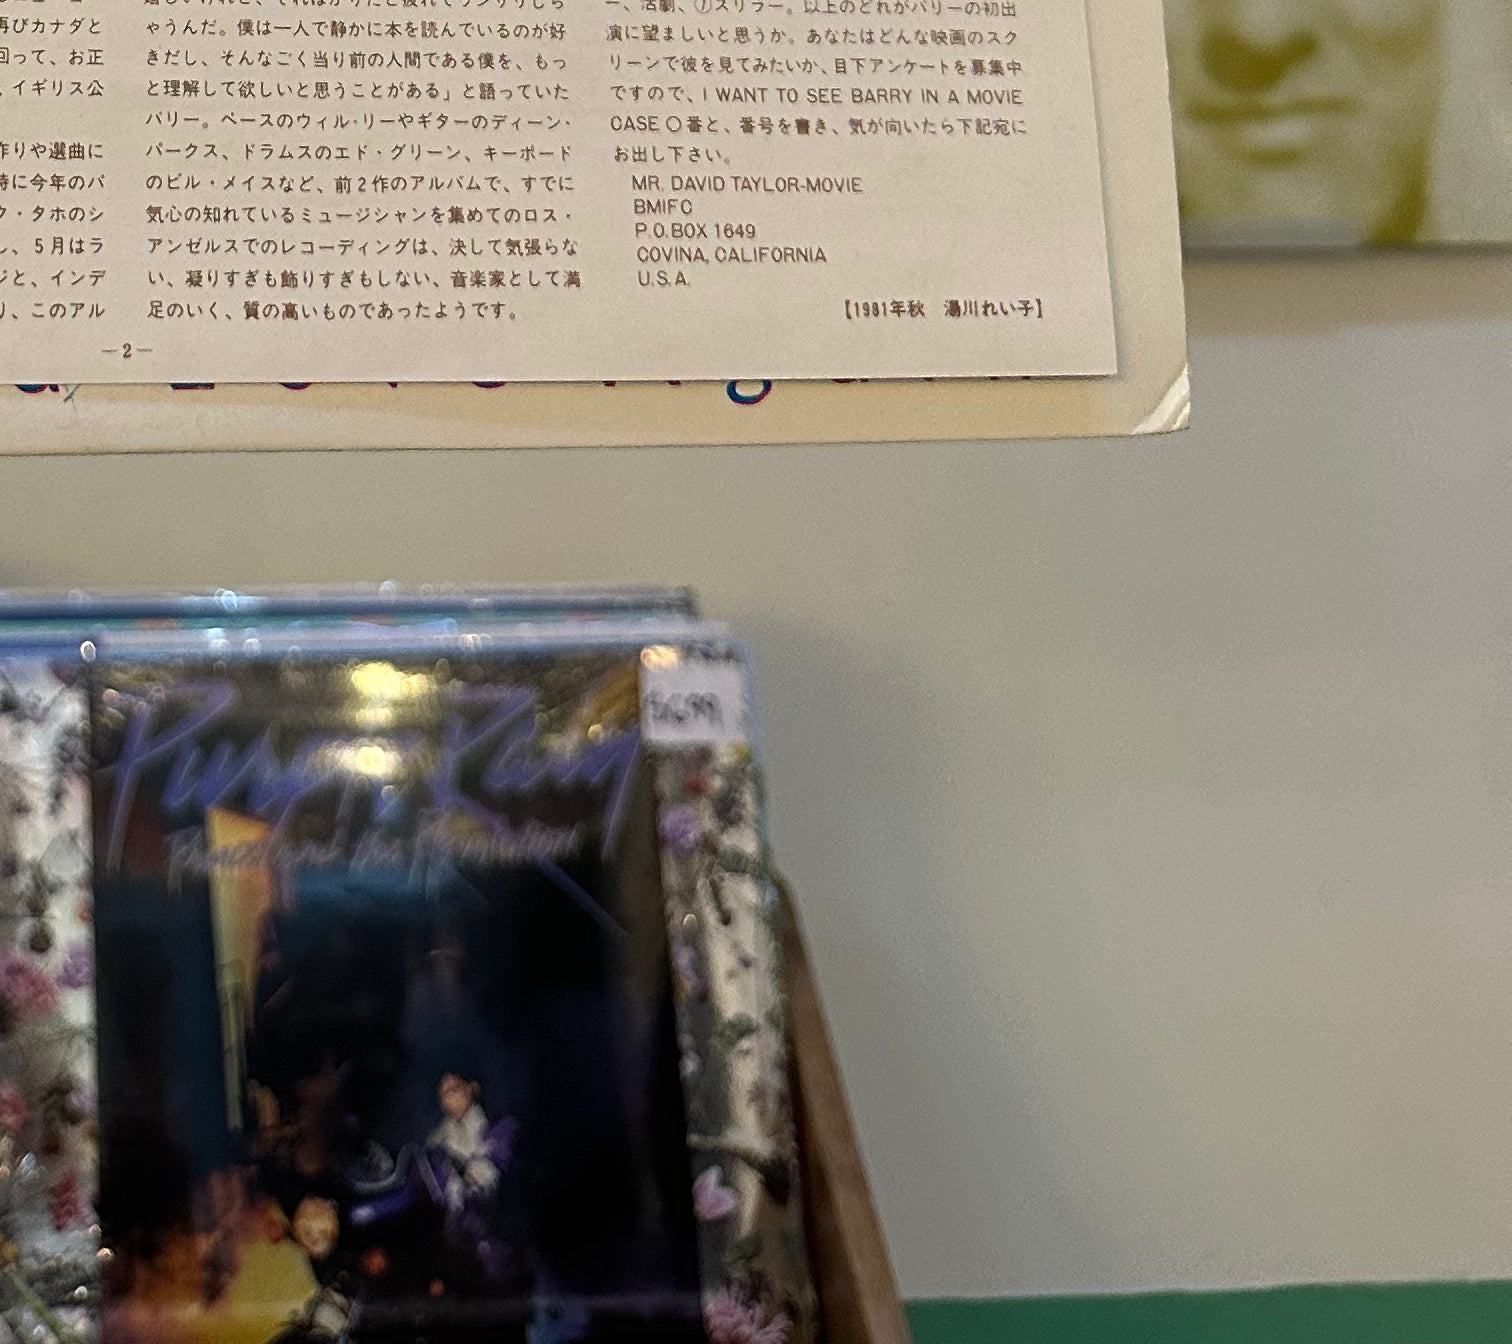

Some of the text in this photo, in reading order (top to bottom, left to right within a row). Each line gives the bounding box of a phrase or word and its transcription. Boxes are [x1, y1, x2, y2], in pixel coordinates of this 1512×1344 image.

[613, 145, 727, 163] お出し下さい。
[631, 174, 863, 193] MR. DAVID TAYLOR-MOVIE
[633, 198, 693, 217] BMIFC
[714, 222, 756, 240] 1649
[636, 245, 828, 264] COVINA, CALIFORNIA
[637, 269, 690, 287] U.S.A.
